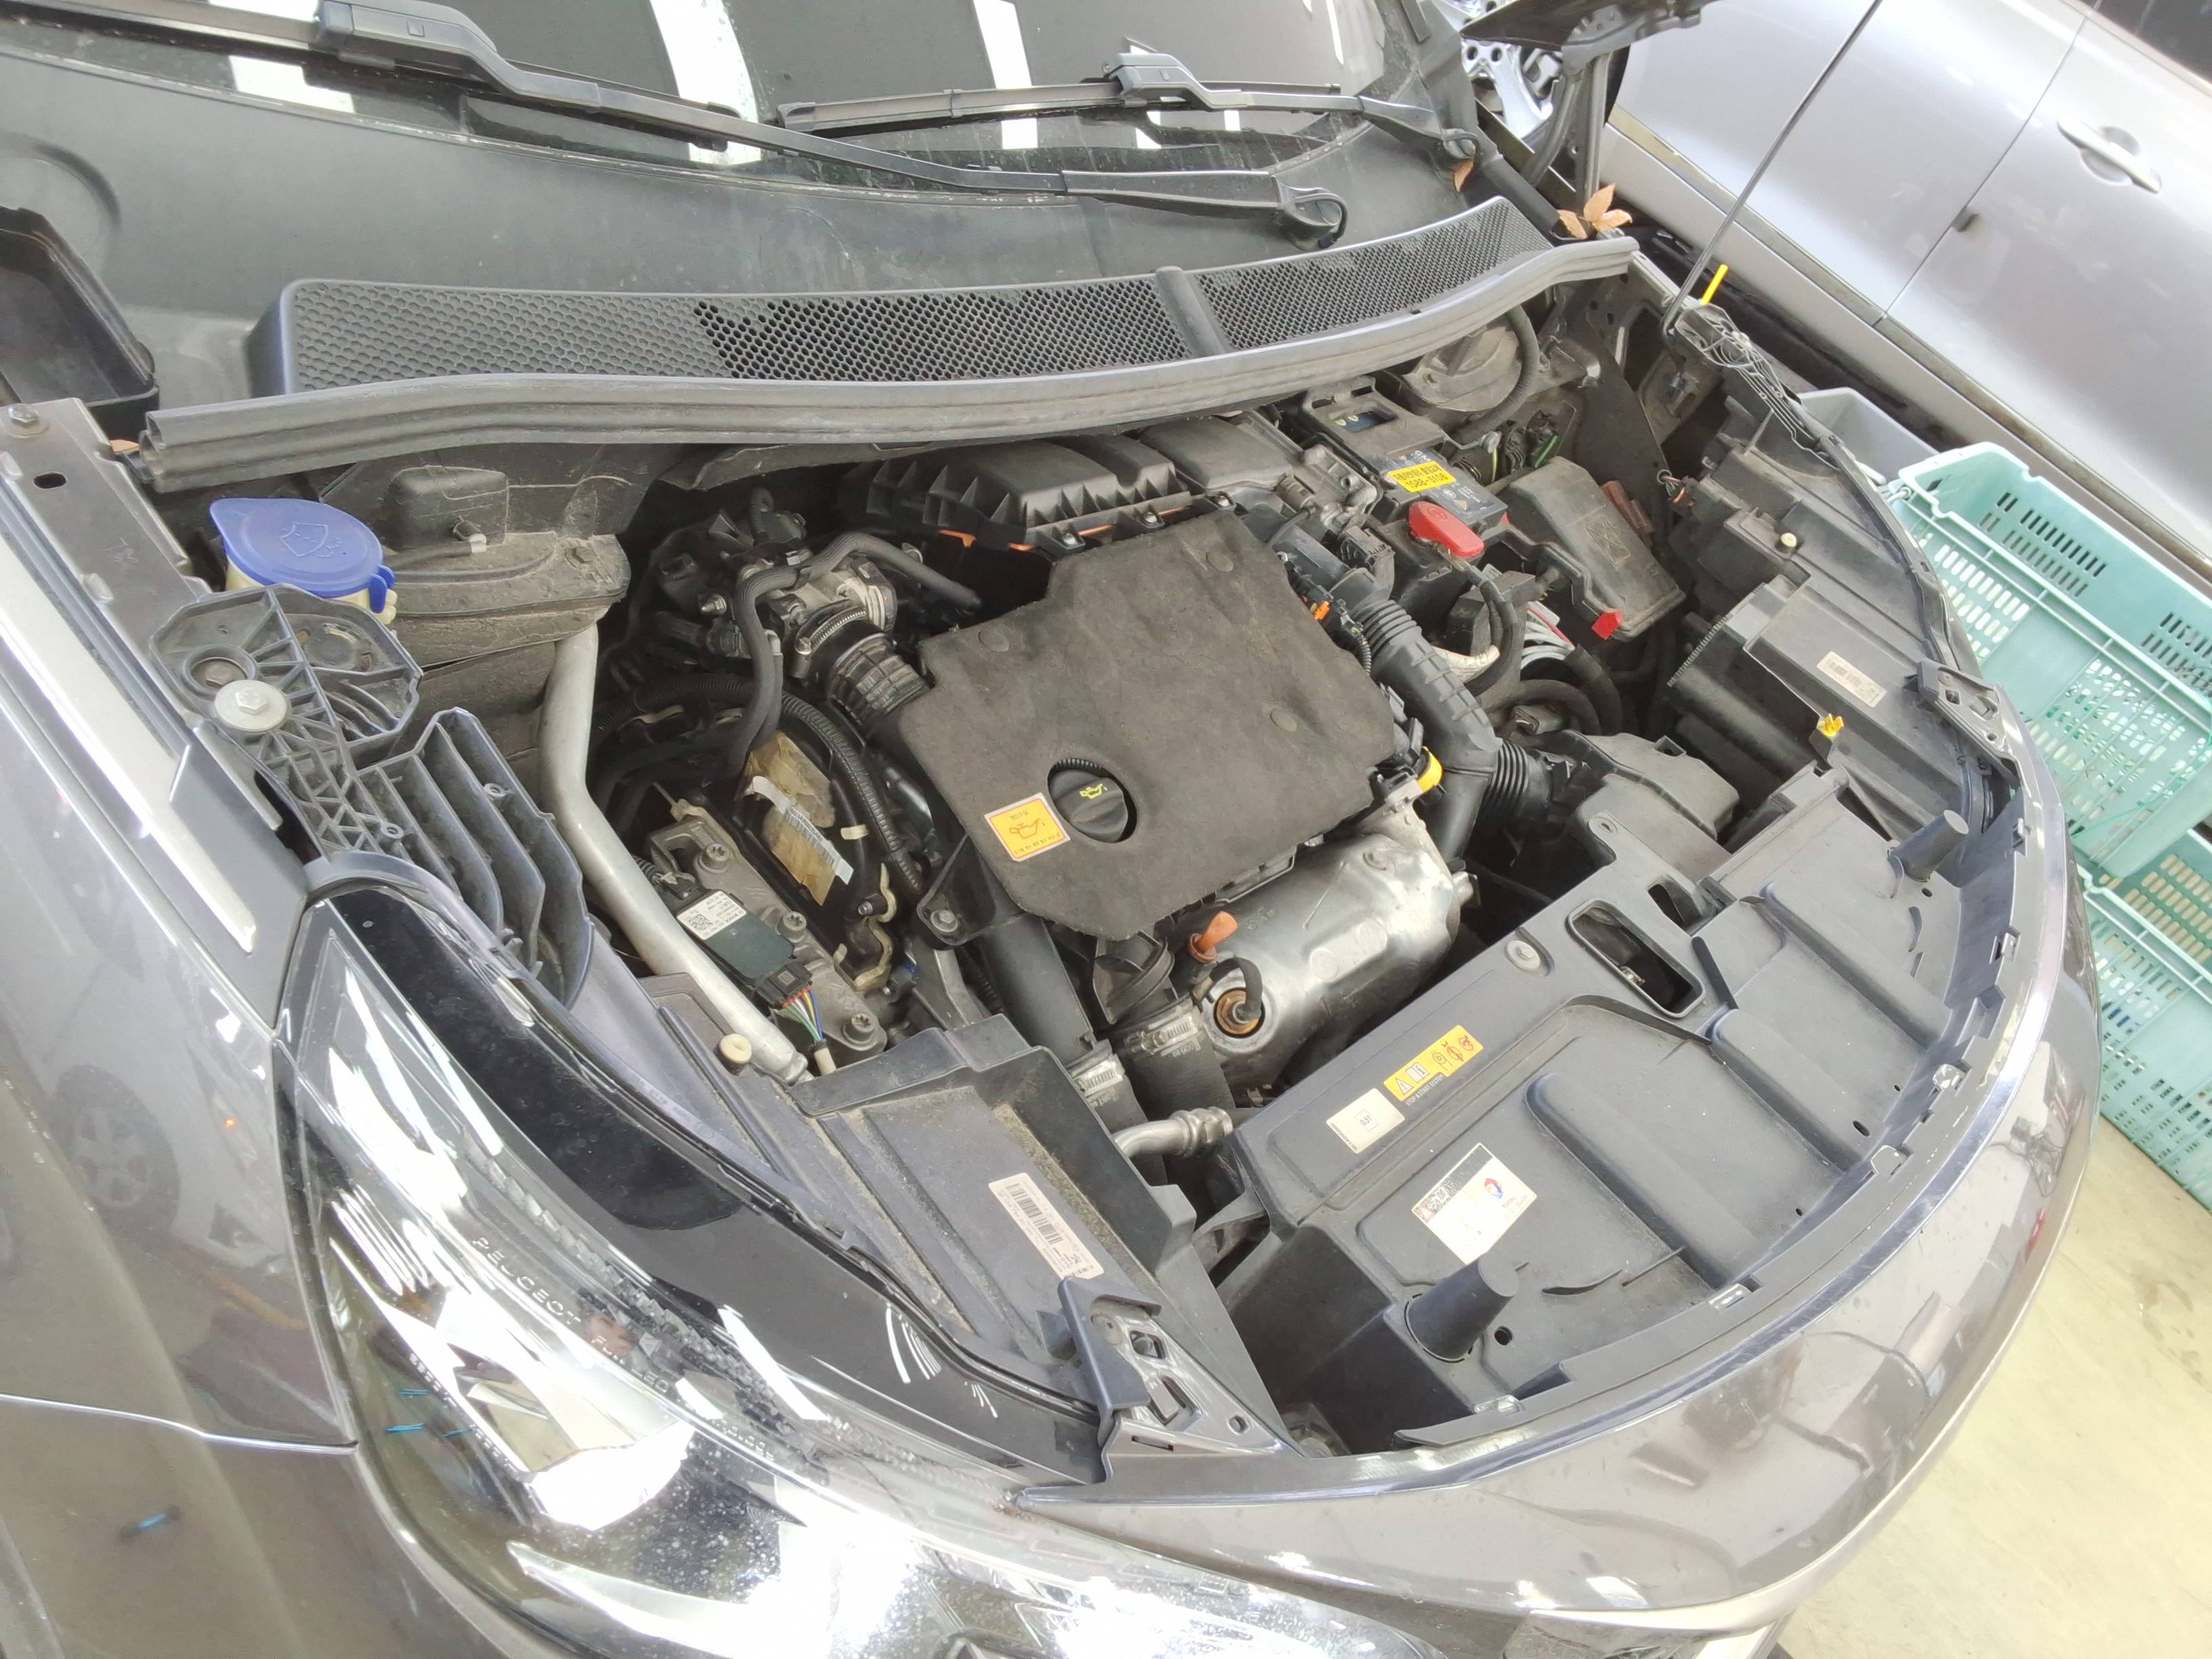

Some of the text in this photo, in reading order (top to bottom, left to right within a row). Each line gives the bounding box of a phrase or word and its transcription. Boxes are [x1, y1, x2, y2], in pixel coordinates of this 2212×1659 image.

[1405, 1094, 1417, 1106] STOP
[1430, 1073, 1445, 1088] SYSTEM
[1501, 1197, 1517, 1209] TOTAL
[472, 1237, 581, 1326] PEUGEOT
[631, 1368, 670, 1393] LED
